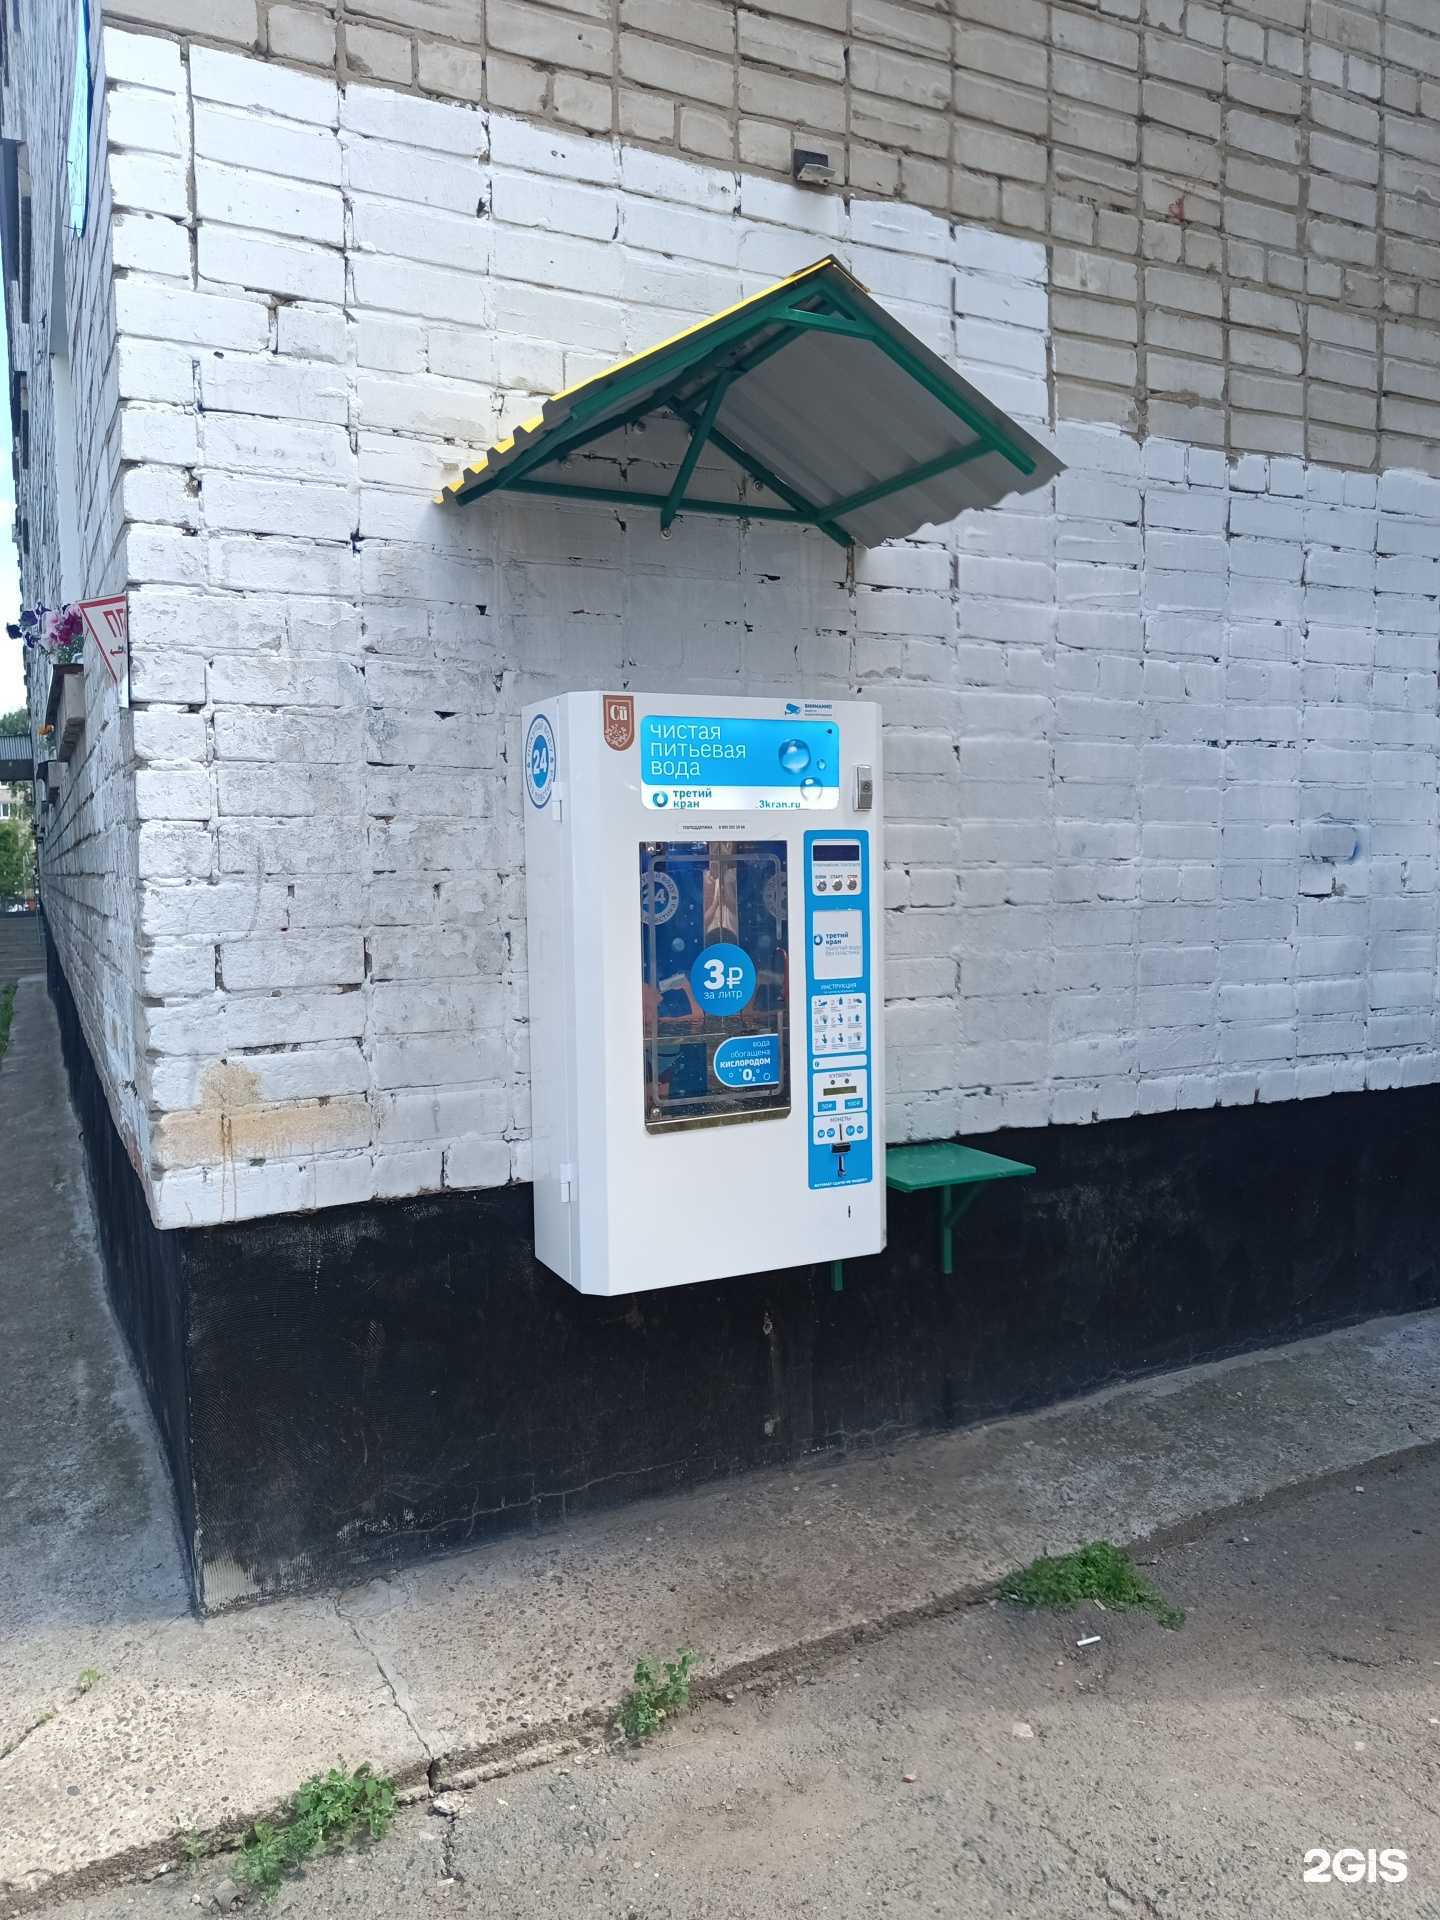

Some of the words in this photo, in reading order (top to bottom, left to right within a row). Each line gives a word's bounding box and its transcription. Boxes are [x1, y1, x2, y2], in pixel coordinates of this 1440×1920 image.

[650, 723, 721, 740] чистая
[650, 742, 746, 760] питьевая
[533, 747, 548, 775] 24
[651, 760, 701, 780] вода
[672, 788, 712, 799] третий
[673, 800, 700, 810] кран
[825, 931, 849, 940] третий
[703, 991, 715, 1000] за
[718, 990, 743, 1000] литр
[752, 1040, 771, 1049] вода
